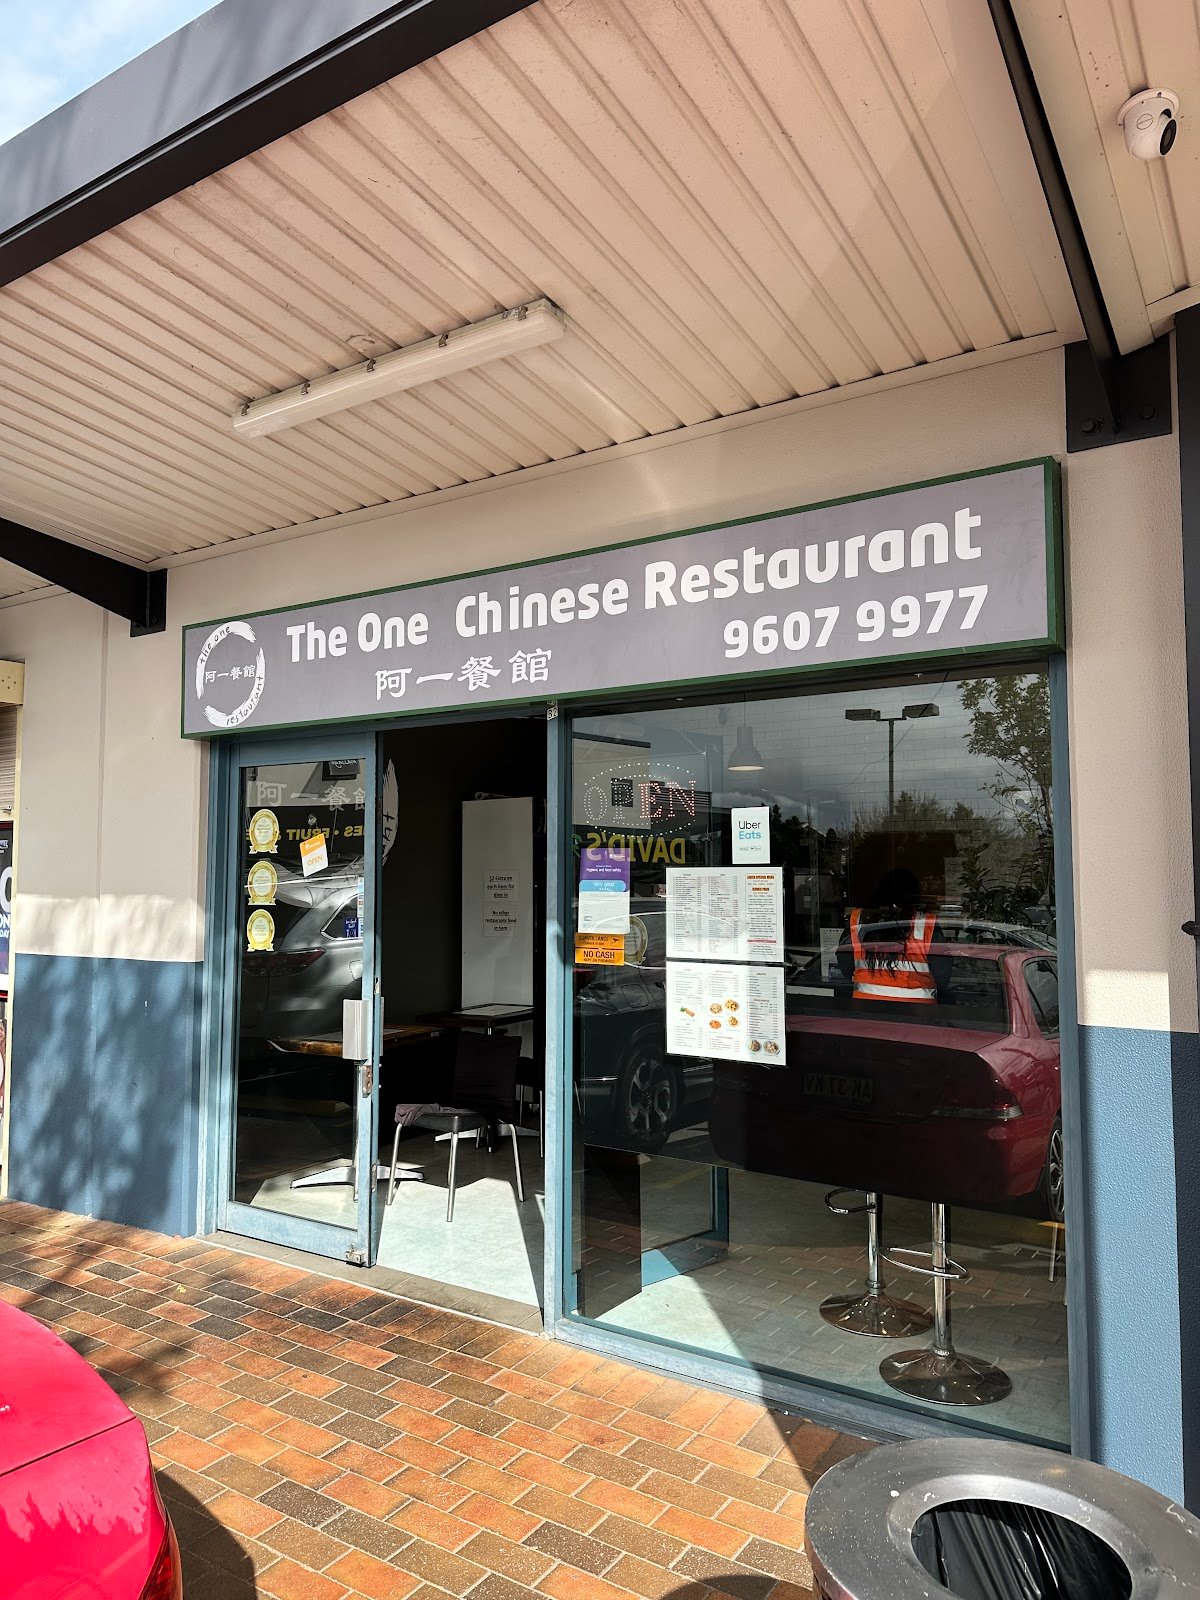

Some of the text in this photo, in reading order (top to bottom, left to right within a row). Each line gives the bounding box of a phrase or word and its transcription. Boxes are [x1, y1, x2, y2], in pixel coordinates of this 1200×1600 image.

[286, 507, 982, 663] The One Chinese Restaurant
[723, 584, 989, 659] 9607 9977
[200, 626, 230, 664] the one
[205, 664, 256, 684] 阿一餐館
[374, 647, 553, 701] 阿一餐館
[583, 780, 697, 820] OPEN
[738, 820, 761, 830] Uber
[738, 831, 762, 840] Eats
[583, 950, 593, 958] NO
